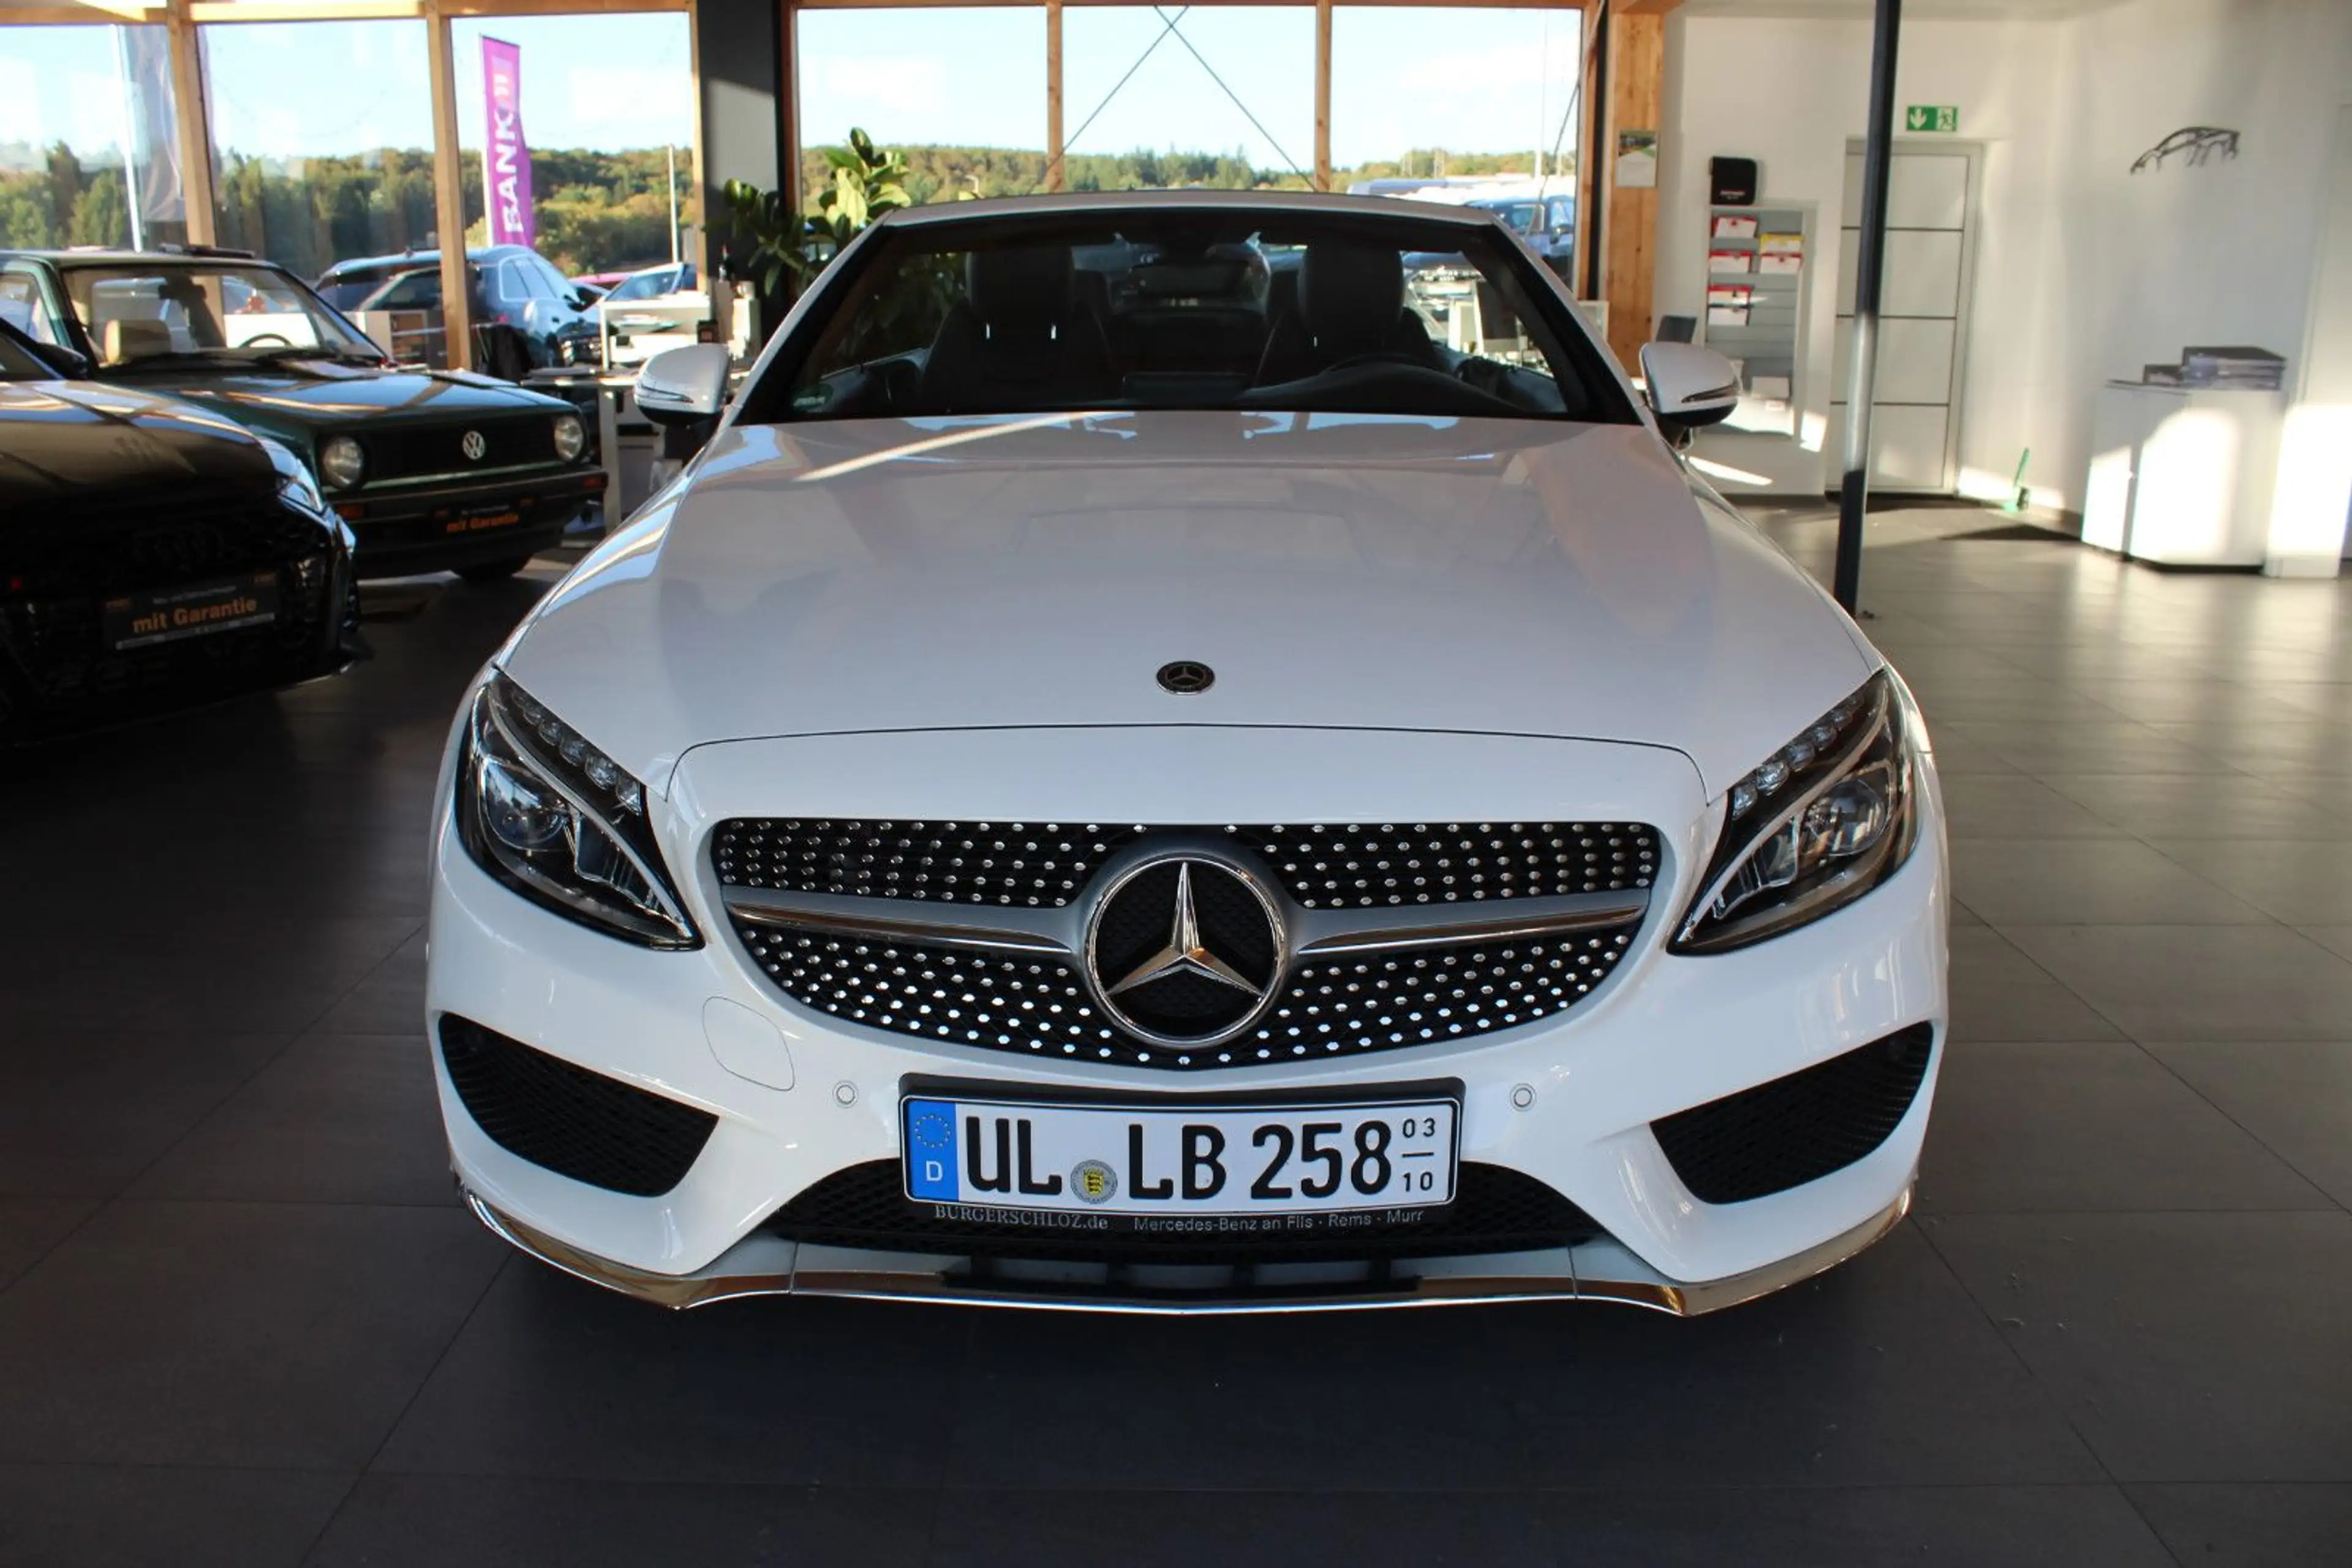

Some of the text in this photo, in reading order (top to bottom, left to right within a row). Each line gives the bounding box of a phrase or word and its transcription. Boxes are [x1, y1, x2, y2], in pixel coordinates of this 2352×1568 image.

[493, 108, 524, 233] BANK
[132, 596, 258, 634] mit Garantie
[1401, 1117, 1436, 1139] 03
[966, 1116, 1063, 1195] UL
[1128, 1123, 1227, 1200] LB
[1250, 1120, 1392, 1199] 258
[925, 1161, 944, 1182] D
[1401, 1171, 1434, 1193] 10
[1134, 1216, 1257, 1232] Mercedes-Benz
[1262, 1218, 1281, 1230] an
[1328, 1213, 1372, 1227] Rems
[1387, 1209, 1424, 1223] Murr
